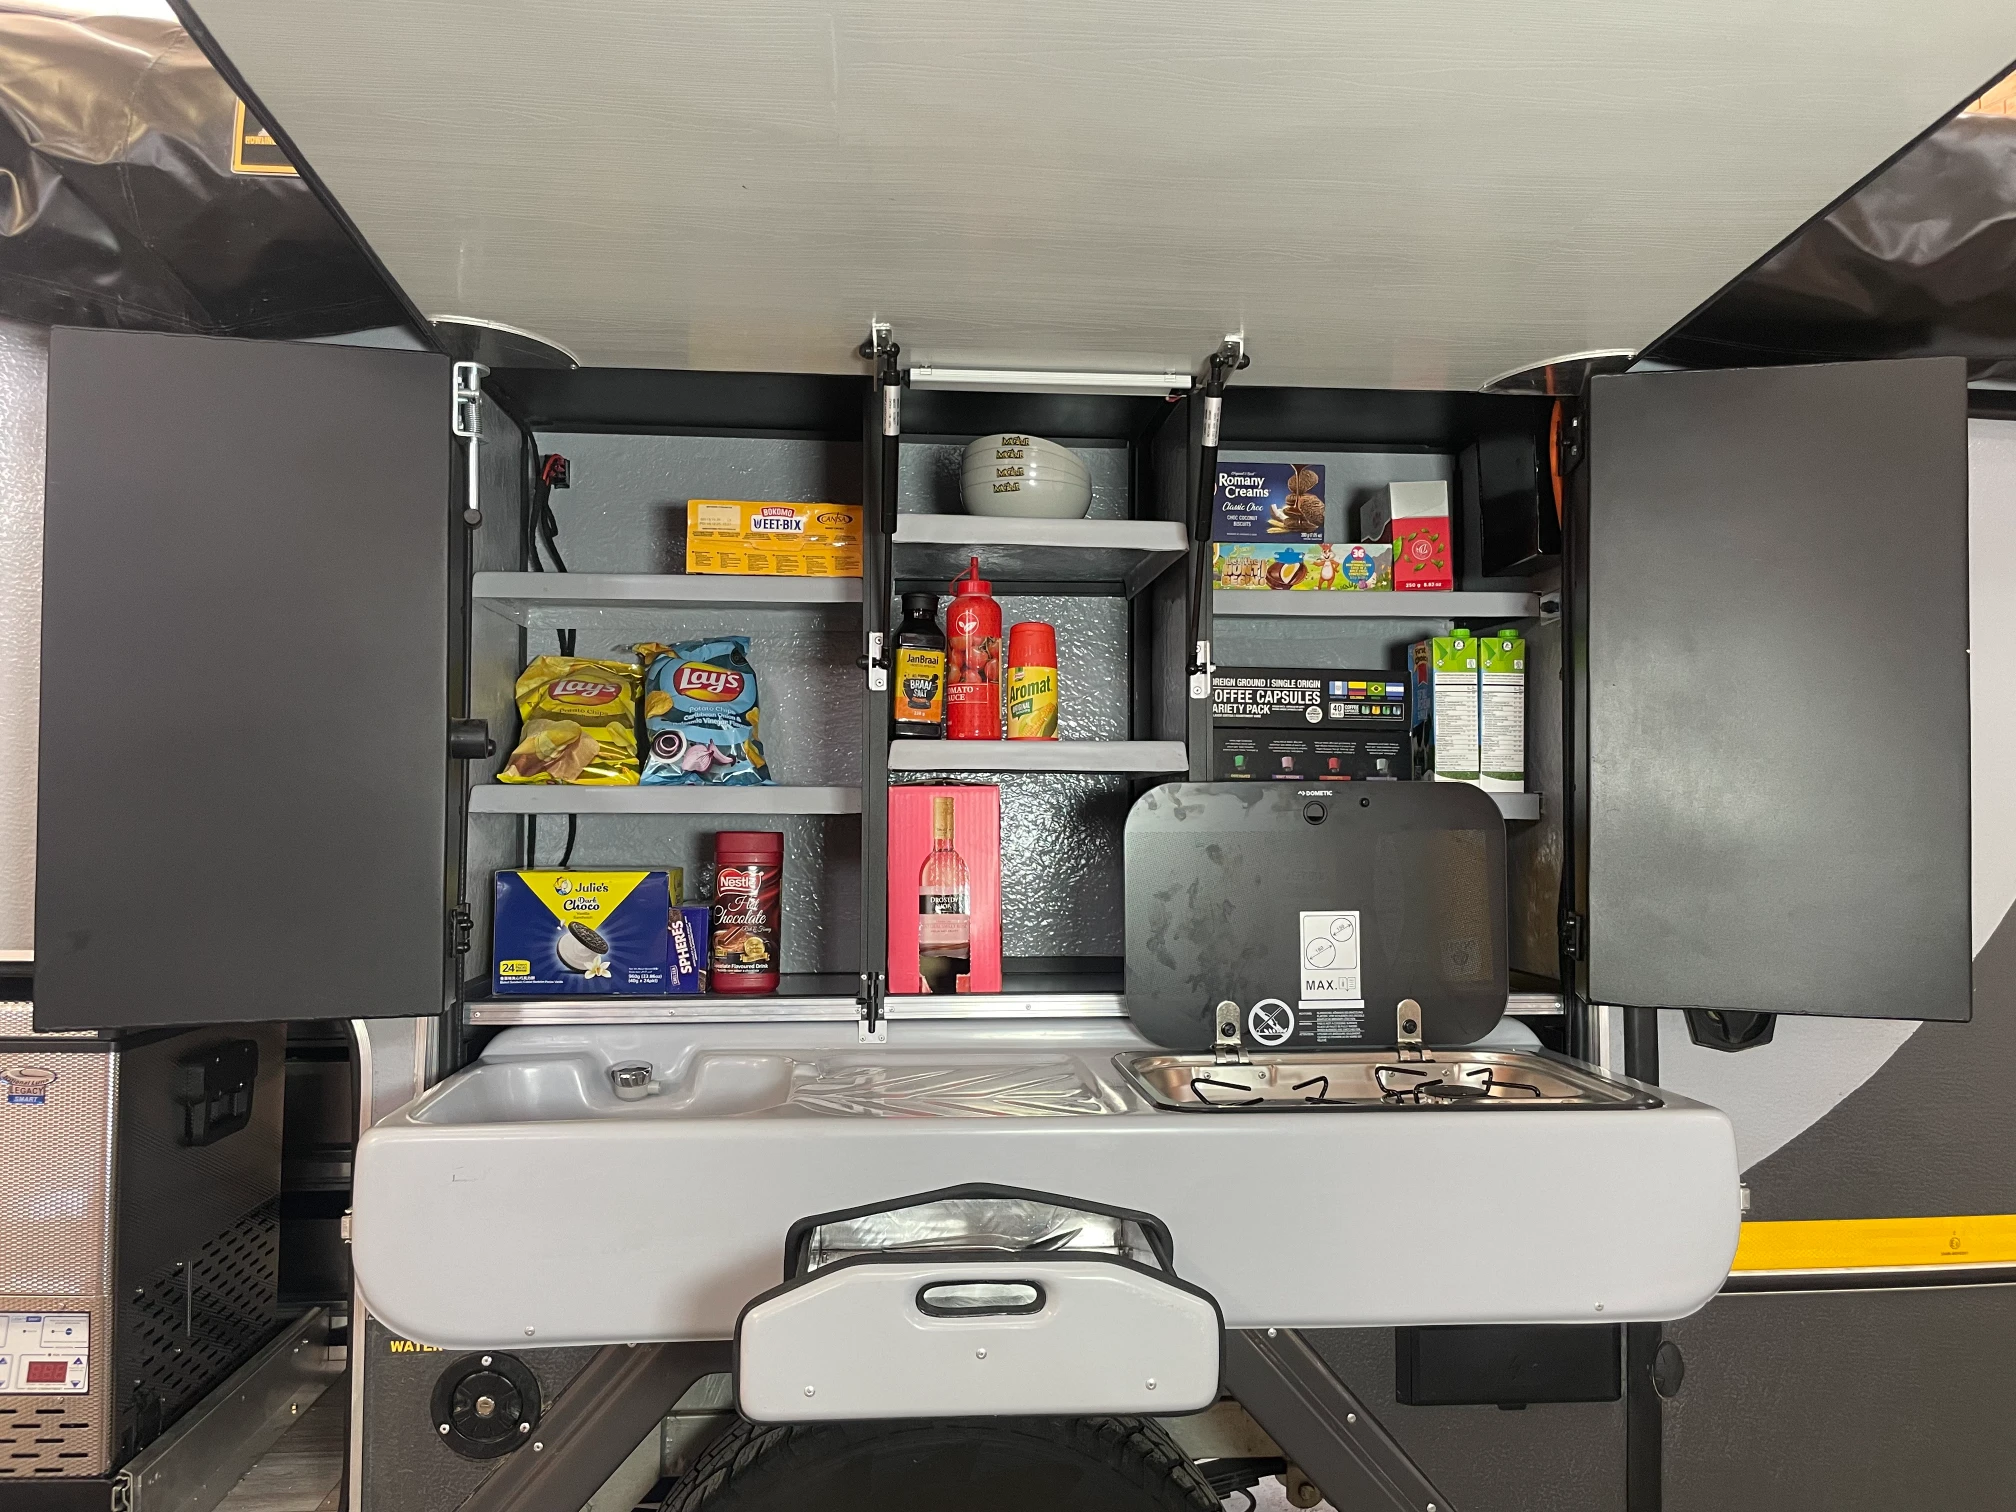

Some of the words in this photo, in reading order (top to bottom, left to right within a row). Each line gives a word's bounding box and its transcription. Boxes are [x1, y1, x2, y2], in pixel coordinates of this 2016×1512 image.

[1219, 473, 1265, 488] Romany
[1225, 486, 1269, 498] Creams
[1222, 502, 1245, 511] Classic
[1246, 502, 1263, 512] Choc
[763, 508, 793, 518] BOKOMO
[753, 518, 802, 531] WEET-BIX
[1352, 549, 1364, 558] 36
[907, 654, 939, 665] JanBraai
[680, 668, 740, 693] Lay's
[1212, 678, 1235, 686] OREIGN
[1237, 679, 1265, 687] GROUND
[1271, 679, 1296, 688] SINGLE
[1297, 680, 1320, 688] ORIGIN
[1010, 676, 1051, 704] Aromat
[1213, 689, 1253, 703] OFFEE
[1256, 690, 1320, 705] CAPSULES
[1212, 703, 1245, 714] ARIETY
[1246, 704, 1271, 714] PACK
[1332, 704, 1343, 712] 40
[575, 882, 609, 892] Julie's
[563, 899, 600, 911] Choco
[714, 905, 767, 926] Chocolate
[502, 963, 515, 973] 24
[1306, 980, 1338, 991] MAX.
[9, 1087, 44, 1095] LEGACY
